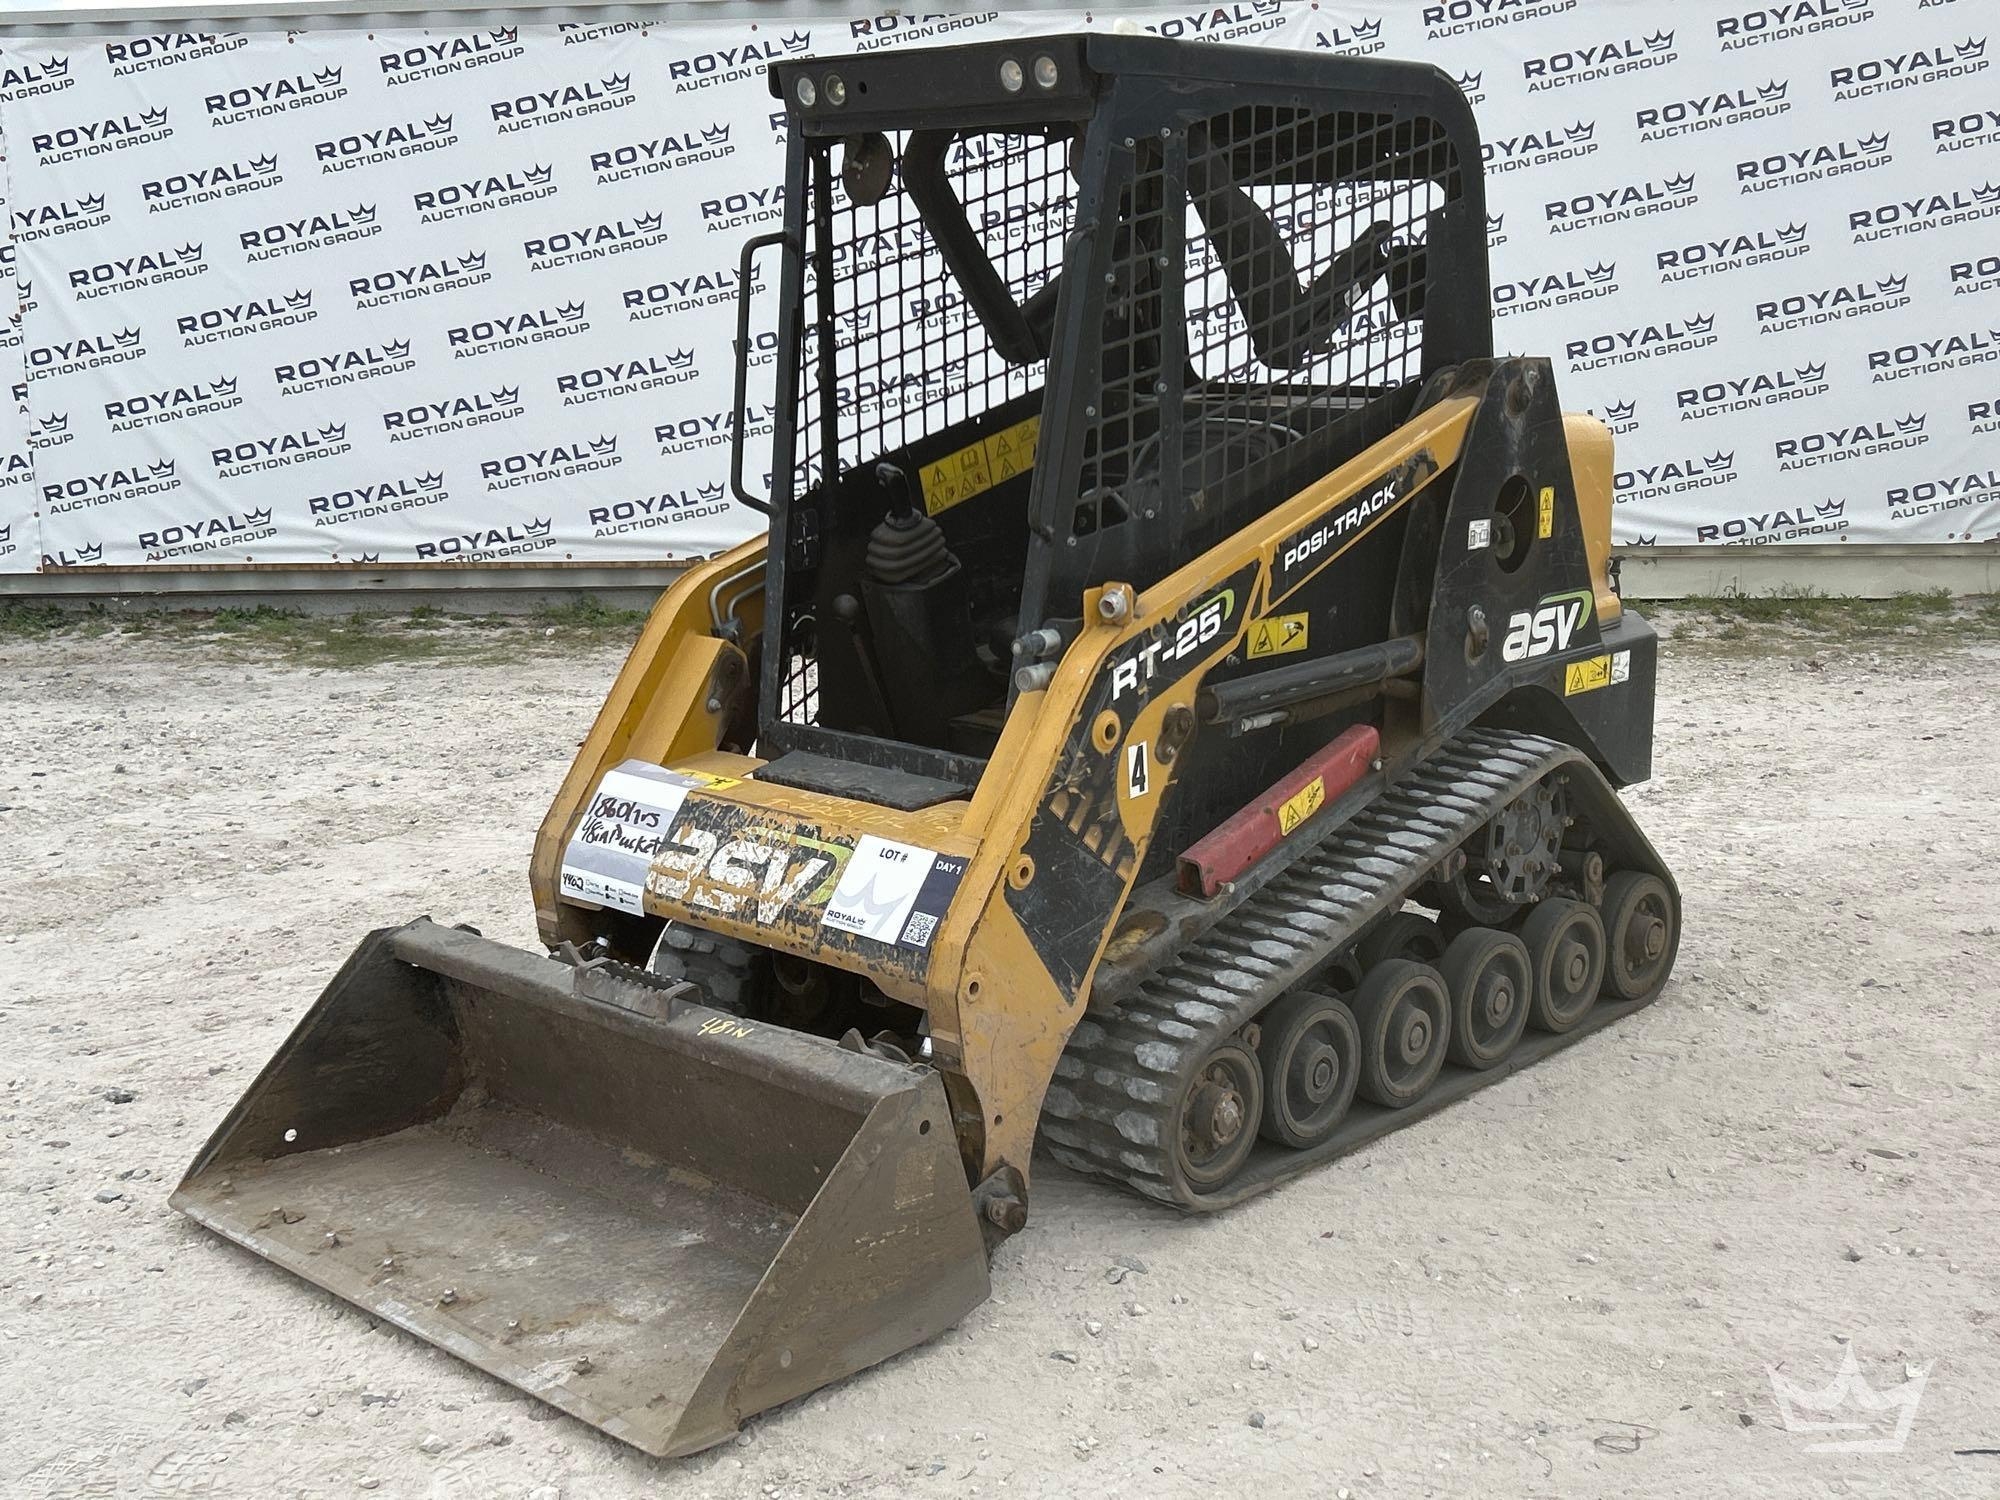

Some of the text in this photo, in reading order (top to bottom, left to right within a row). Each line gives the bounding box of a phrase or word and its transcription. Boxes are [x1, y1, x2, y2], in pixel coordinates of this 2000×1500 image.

[564, 22, 639, 46] AUCTION
[857, 12, 999, 52] AUCTION GROUP
[1224, 17, 1286, 40] GROUP
[1428, 0, 1576, 40] AUCTION GROUP
[1717, 0, 1839, 38] ROYAL
[1721, 11, 1874, 52] AUCTION GROUP
[114, 38, 248, 77] AUCTION GROUP
[380, 35, 491, 73] ROYAL
[387, 47, 524, 87] AUCTION GROUP
[669, 41, 782, 80] ROYAL
[1524, 40, 1643, 79] ROYAL
[1831, 48, 1954, 88] ROYAL
[16, 79, 74, 99] GROUP
[676, 68, 750, 94] AUCTION
[1528, 53, 1678, 93] AUCTION GROUP
[1835, 60, 1989, 102] AUCTION GROUP
[205, 76, 315, 114] ROYAL
[212, 88, 347, 127] AUCTION GROUP
[491, 83, 603, 121] ROYAL
[1637, 90, 1756, 128] ROYAL
[498, 95, 635, 134] AUCTION GROUP
[1641, 103, 1790, 142] AUCTION GROUP
[32, 116, 141, 153] ROYAL
[40, 128, 173, 166] AUCTION GROUP
[315, 124, 426, 161] ROYAL
[590, 134, 702, 171] ROYAL
[322, 136, 458, 174] AUCTION GROUP
[597, 146, 735, 185] AUCTION GROUP
[1534, 143, 1598, 164] GROUP
[1737, 142, 1857, 181] ROYAL
[142, 163, 251, 200] ROYAL
[414, 174, 525, 210] ROYAL
[1741, 155, 1892, 194] AUCTION GROUP
[150, 176, 283, 214] AUCTION GROUP
[421, 186, 557, 224] AUCTION GROUP
[1545, 183, 1664, 220] ROYAL
[1849, 192, 1972, 230] ROYAL
[53, 214, 111, 235] GROUP
[240, 213, 350, 250] ROYAL
[707, 208, 782, 233] AUCTION
[1550, 196, 1698, 234] AUCTION GROUP
[1854, 219, 1936, 244] AUCTION
[248, 225, 382, 263] AUCTION GROUP
[524, 222, 635, 258] ROYAL
[531, 234, 668, 272] AUCTION GROUP
[1657, 232, 1776, 270] ROYAL
[69, 252, 176, 288] ROYAL
[76, 264, 208, 301] AUCTION GROUP
[350, 260, 459, 297] ROYAL
[1661, 245, 1810, 283] AUCTION GROUP
[357, 273, 491, 310] AUCTION GROUP
[623, 272, 734, 308] ROYAL
[1555, 284, 1619, 306] GROUP
[1756, 284, 1876, 321] ROYAL
[177, 299, 286, 334] ROYAL
[448, 310, 558, 346] ROYAL
[630, 298, 704, 322] AUCTION
[1760, 296, 1910, 334] AUCTION GROUP
[184, 311, 317, 348] AUCTION GROUP
[455, 323, 590, 359] AUCTION GROUP
[1566, 323, 1684, 360] ROYAL
[89, 348, 146, 368] GROUP
[274, 348, 384, 383] ROYAL
[1571, 336, 1717, 373] AUCTION GROUP
[1868, 333, 1989, 370] ROYAL
[282, 360, 416, 396] AUCTION GROUP
[557, 358, 667, 393] ROYAL
[564, 370, 699, 406] AUCTION GROUP
[1677, 372, 1795, 408] ROYAL
[1872, 360, 1954, 383] AUCTION
[104, 385, 211, 420] ROYAL
[112, 397, 242, 433] AUCTION GROUP
[383, 395, 492, 430] ROYAL
[1681, 384, 1829, 421] AUCTION GROUP
[390, 407, 524, 443] AUCTION GROUP
[1776, 423, 1895, 458] ROYAL
[212, 432, 320, 466] ROYAL
[219, 444, 351, 479] AUCTION GROUP
[481, 444, 590, 478] ROYAL
[1780, 435, 1929, 472] AUCTION GROUP
[42, 468, 150, 502] ROYAL
[488, 456, 622, 492] AUCTION GROUP
[1674, 472, 1737, 492] GROUP
[50, 480, 181, 515] AUCTION GROUP
[309, 480, 417, 514] ROYAL
[316, 492, 448, 527] AUCTION GROUP
[589, 491, 698, 525] ROYAL
[1891, 496, 1972, 520] AUCTION
[139, 516, 246, 550] ROYAL
[220, 528, 277, 546] GROUP
[595, 503, 730, 538] AUCTION GROUP
[1284, 481, 1396, 572] POSI-TRACK
[1697, 508, 1815, 542] ROYAL
[1785, 521, 1849, 539] GROUP
[416, 526, 525, 560] ROYAL
[498, 538, 556, 556] GROUP
[1113, 602, 1220, 701] RT-25
[1132, 745, 1145, 792] 4
[879, 847, 901, 861] LOT
[936, 860, 955, 874] DAY
[827, 909, 857, 925] ROYAL
